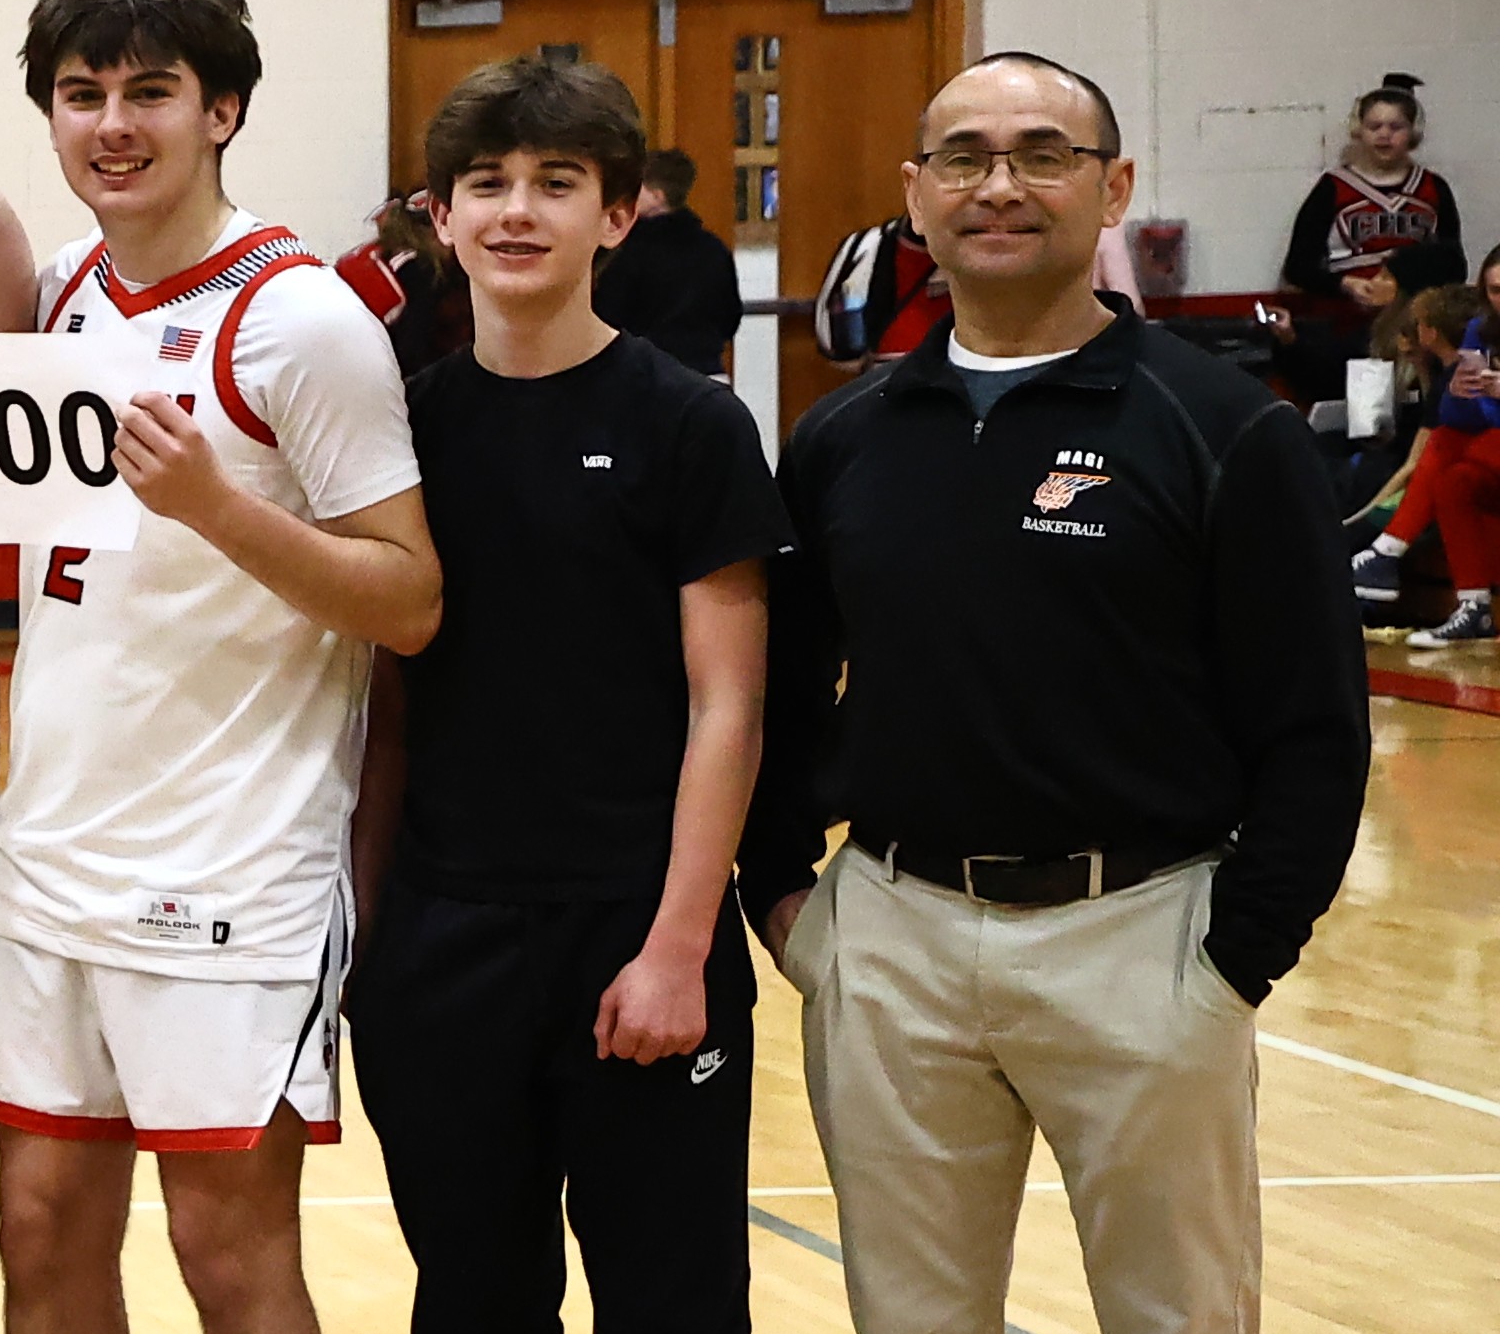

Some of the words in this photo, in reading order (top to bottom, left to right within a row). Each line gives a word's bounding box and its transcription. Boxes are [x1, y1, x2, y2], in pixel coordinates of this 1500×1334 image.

[582, 454, 613, 469] VANS
[1055, 450, 1104, 470] MAGI
[1022, 516, 1107, 537] BASKETBALL
[137, 917, 201, 930] PROLOOK
